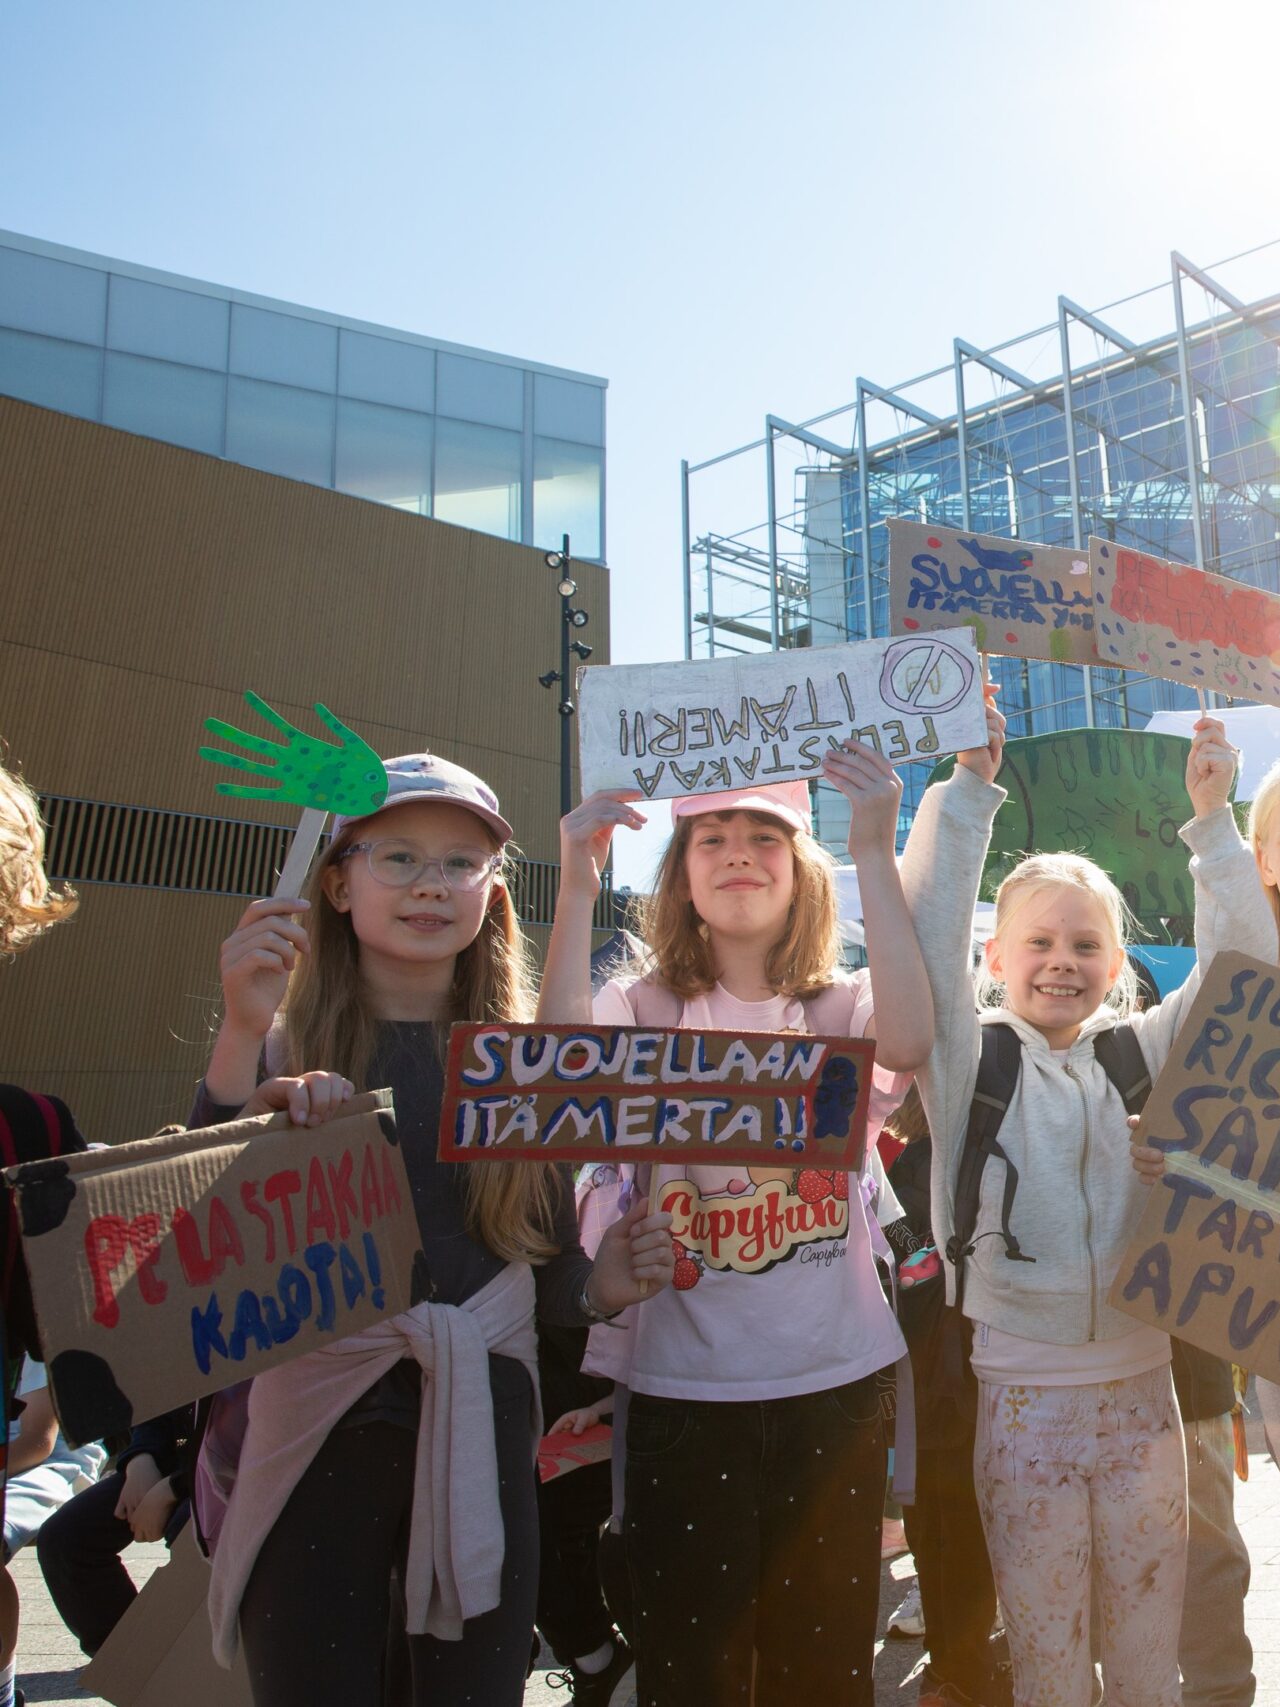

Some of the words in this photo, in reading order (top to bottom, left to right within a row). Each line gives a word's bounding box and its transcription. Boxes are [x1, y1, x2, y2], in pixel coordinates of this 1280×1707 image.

[461, 1031, 826, 1086] SUOJELLAAN
[455, 1092, 806, 1153] ITÄMERTA!!
[85, 1143, 400, 1328] PELASTAKAA
[661, 1191, 844, 1263] Capyfun
